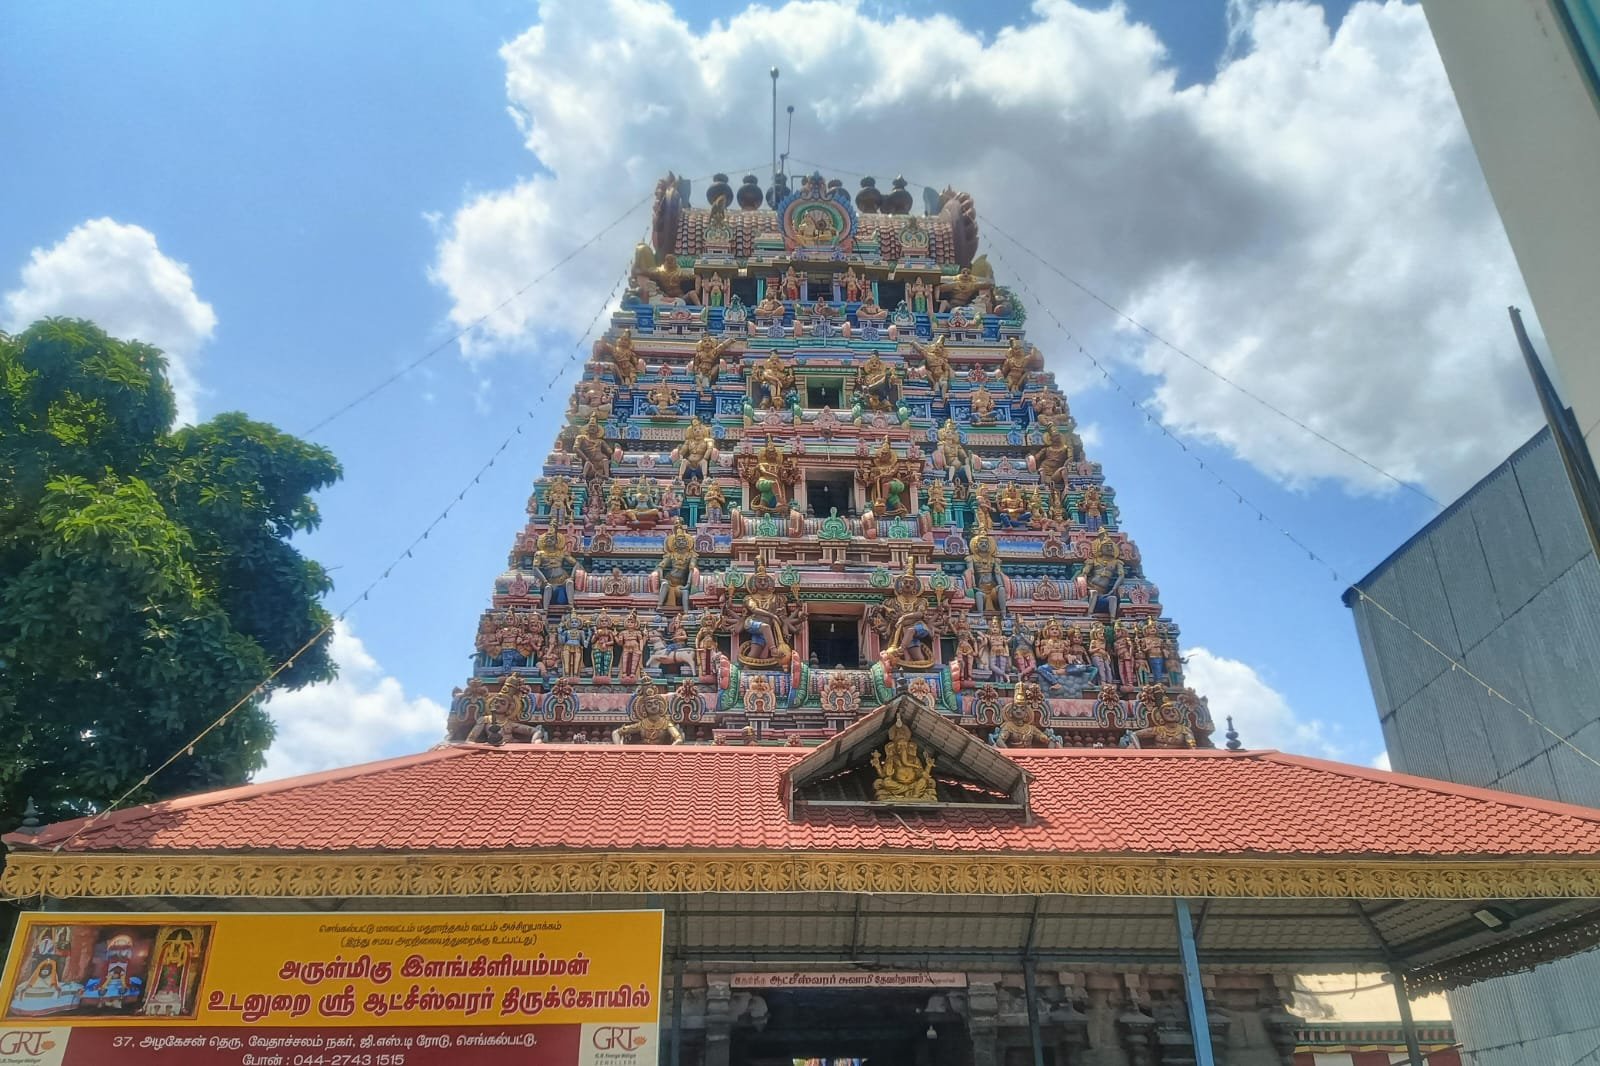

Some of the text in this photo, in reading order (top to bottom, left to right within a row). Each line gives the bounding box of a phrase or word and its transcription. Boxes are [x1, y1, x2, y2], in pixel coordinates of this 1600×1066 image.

[278, 951, 590, 985] அருள்மிகு இளங்கிளியம்மன்
[207, 983, 651, 1023] உடனுறை ஸ்ரீ ஆட்சீஸ்வரர் திருக்கோயில்
[0, 1030, 52, 1056] GRT
[139, 1035, 206, 1051] அழகேசன்
[248, 1034, 323, 1051] வேதாச்சலம்
[593, 1026, 640, 1051] GRT
[242, 1053, 282, 1066] போன்
[293, 1055, 372, 1066] 044-2743
[375, 1054, 405, 1065] 1515
